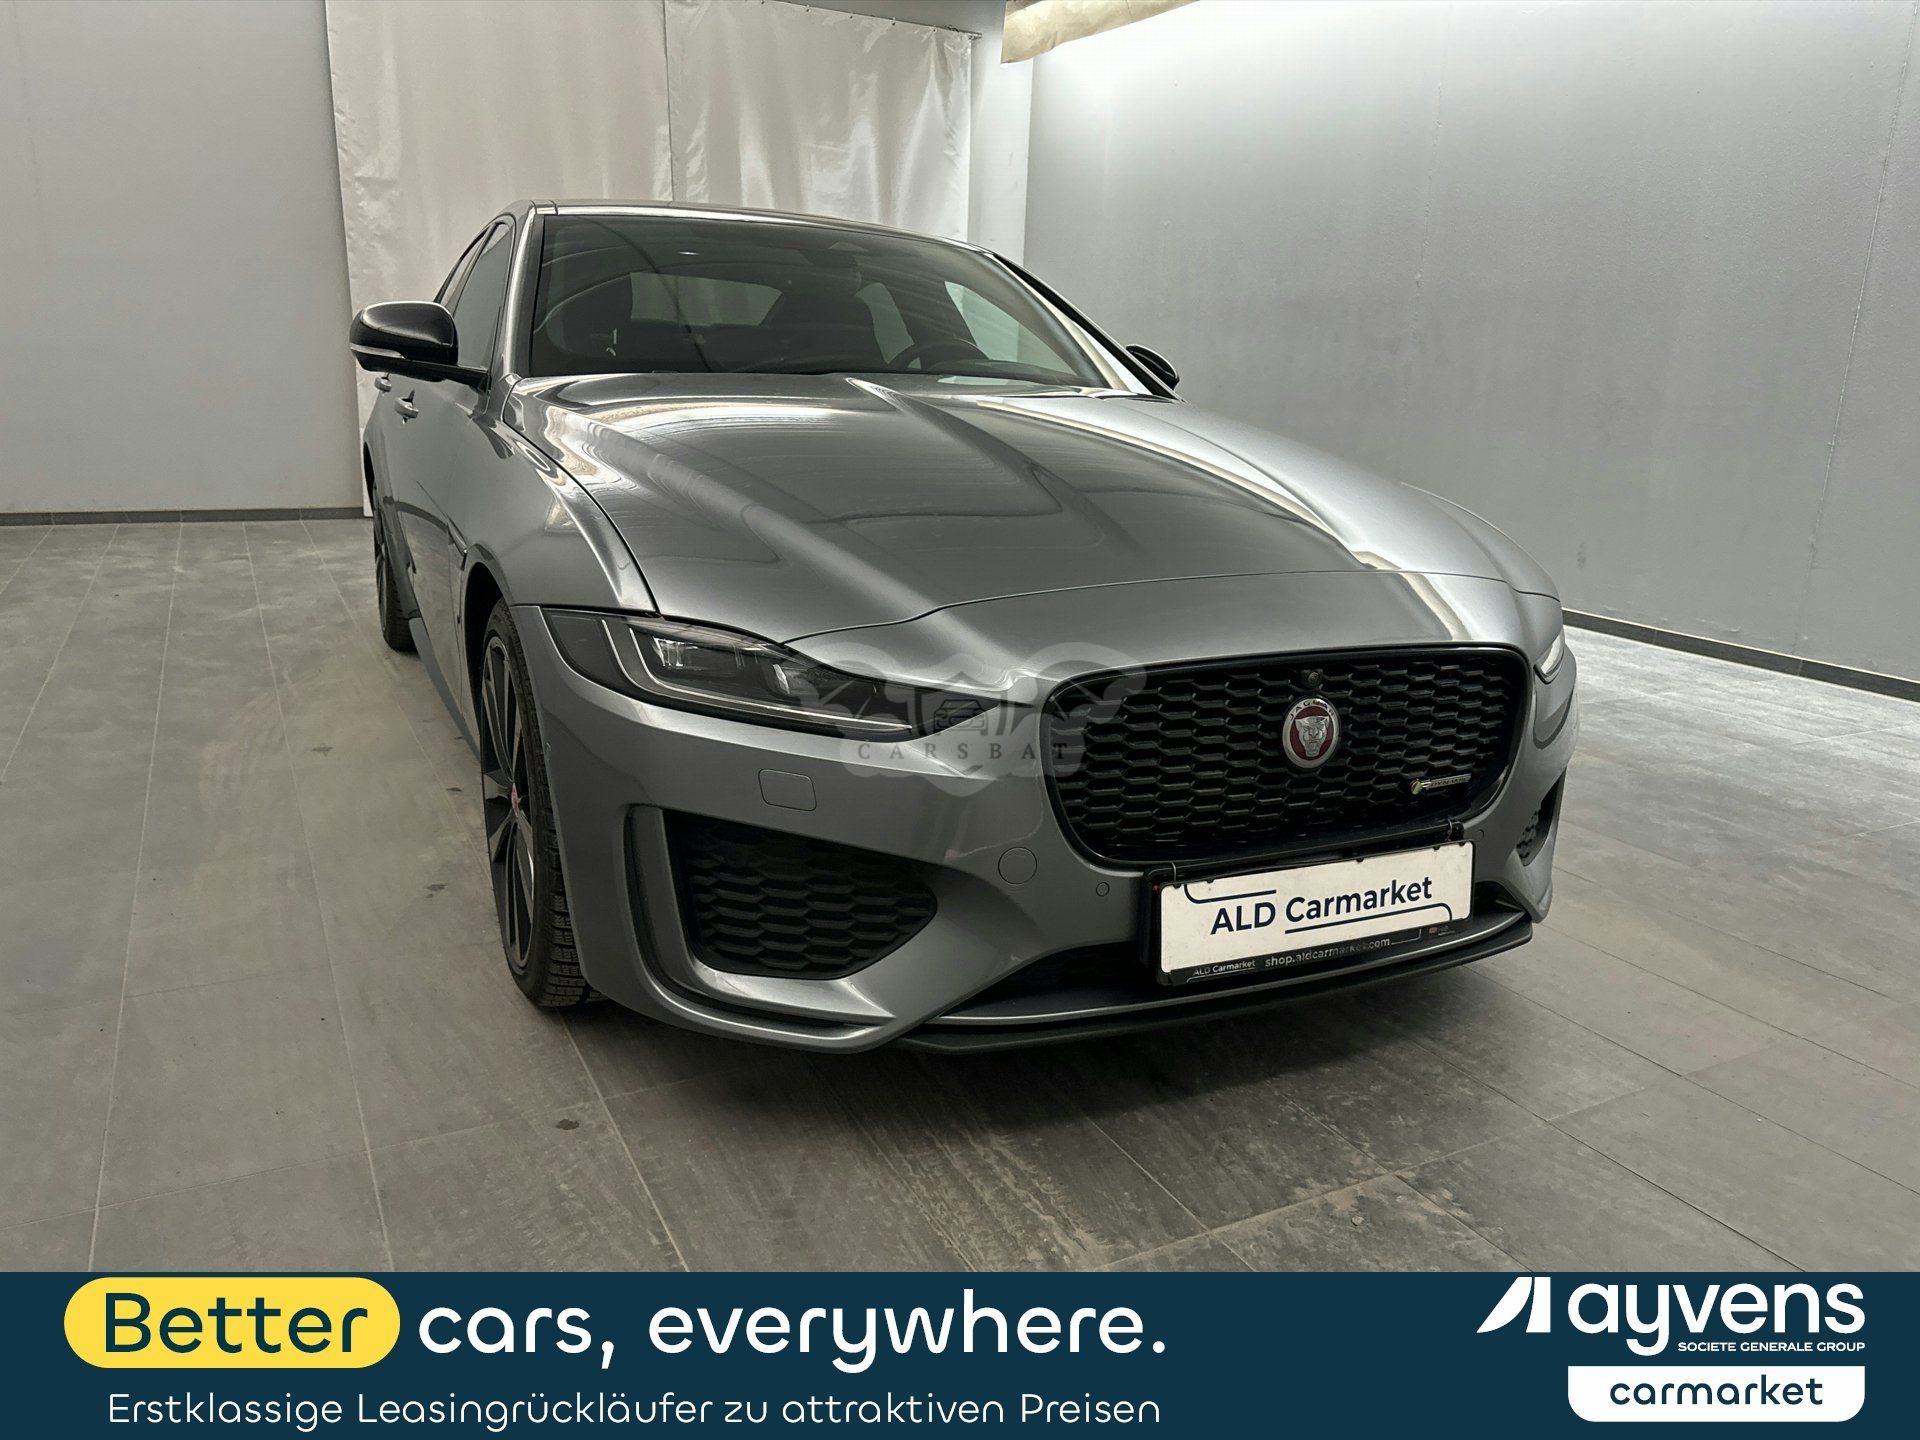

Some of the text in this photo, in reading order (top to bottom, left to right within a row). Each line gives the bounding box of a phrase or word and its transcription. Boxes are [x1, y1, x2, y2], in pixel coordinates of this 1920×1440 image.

[1210, 876, 1433, 936] ALD Carmarket
[1193, 966, 1211, 977] ALD
[1212, 959, 1256, 974] Carmarket
